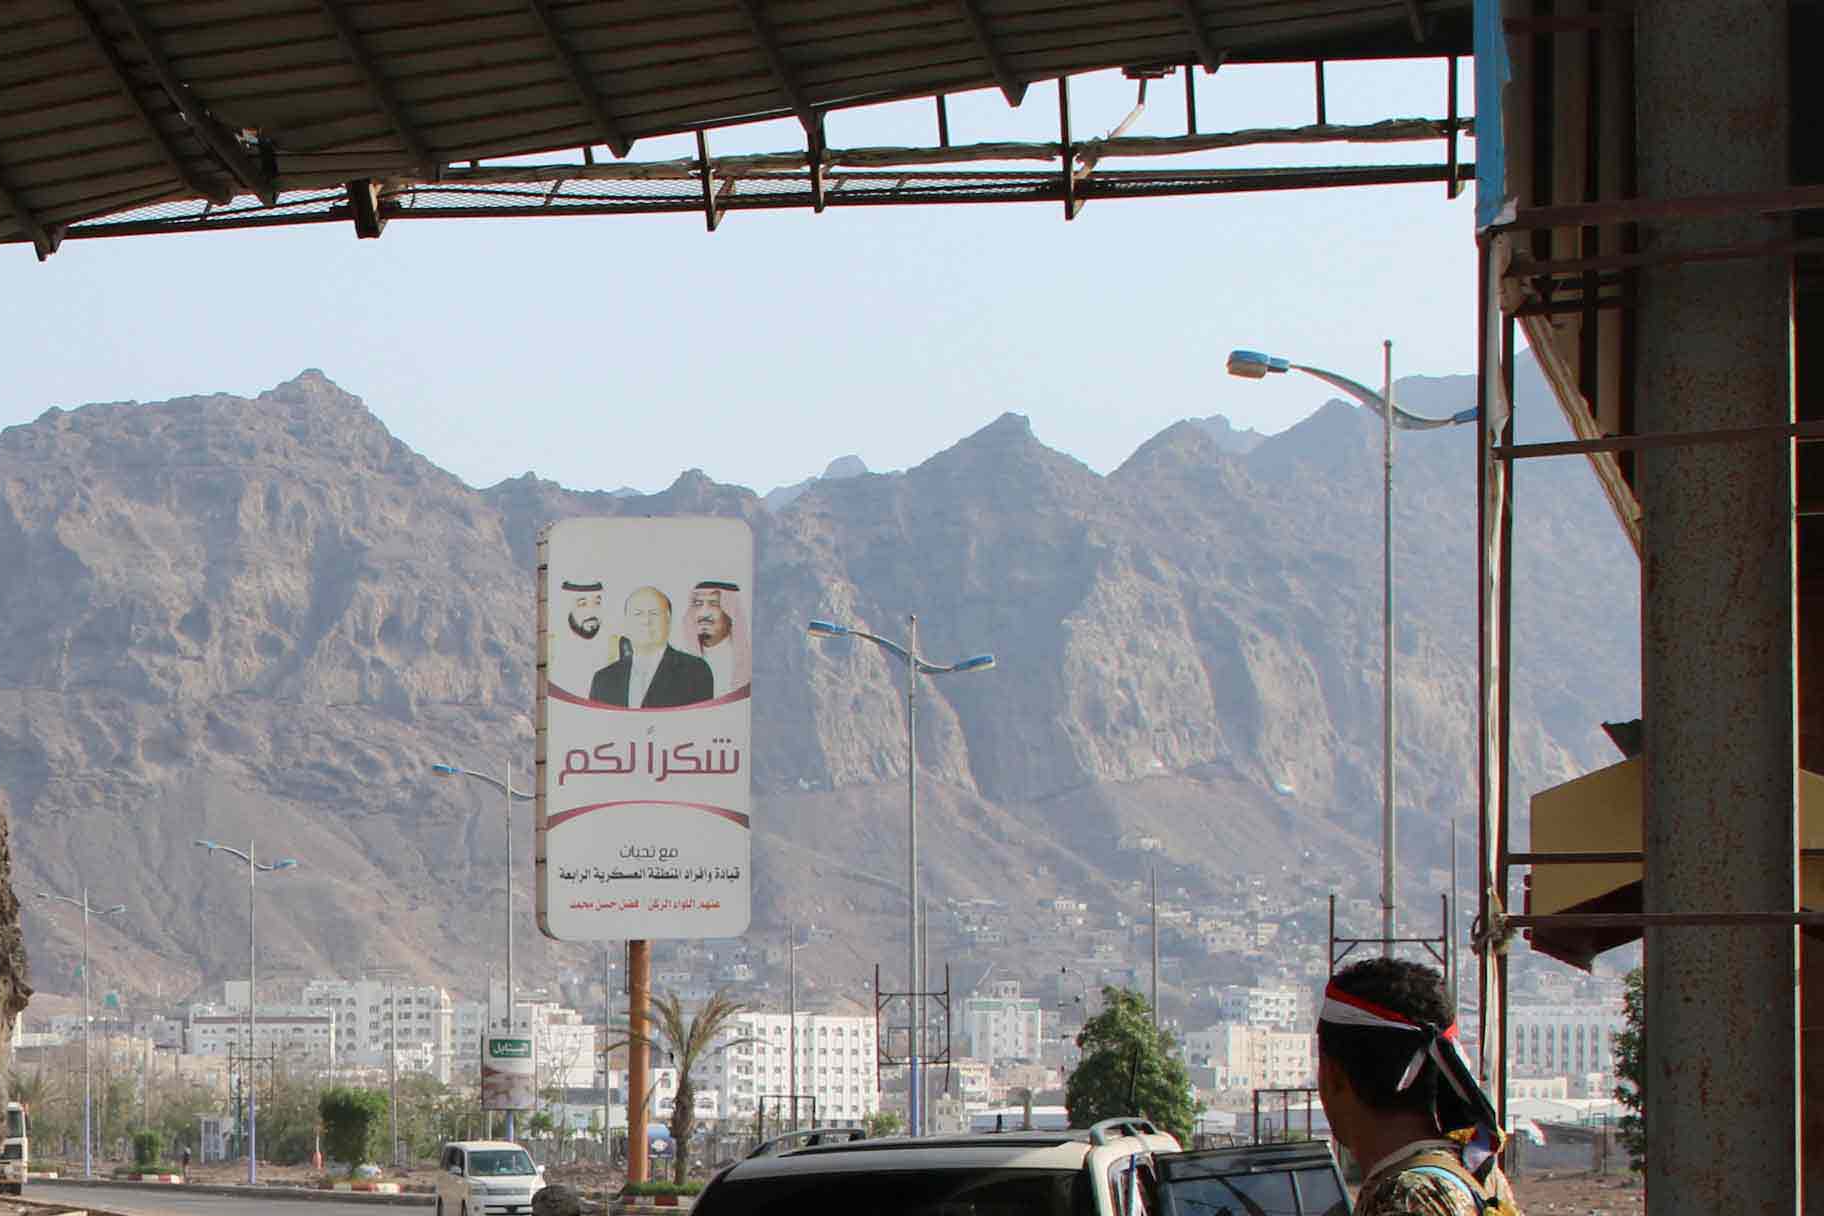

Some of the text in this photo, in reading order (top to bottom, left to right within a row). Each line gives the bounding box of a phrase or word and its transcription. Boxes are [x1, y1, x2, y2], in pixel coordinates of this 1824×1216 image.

[558, 741, 637, 786] لكم
[619, 844, 679, 862] مع تحيات
[559, 866, 591, 885] الرابعة
[593, 866, 646, 885] العسكرية
[648, 866, 682, 881] المنطقة
[713, 865, 741, 884] قيادة
